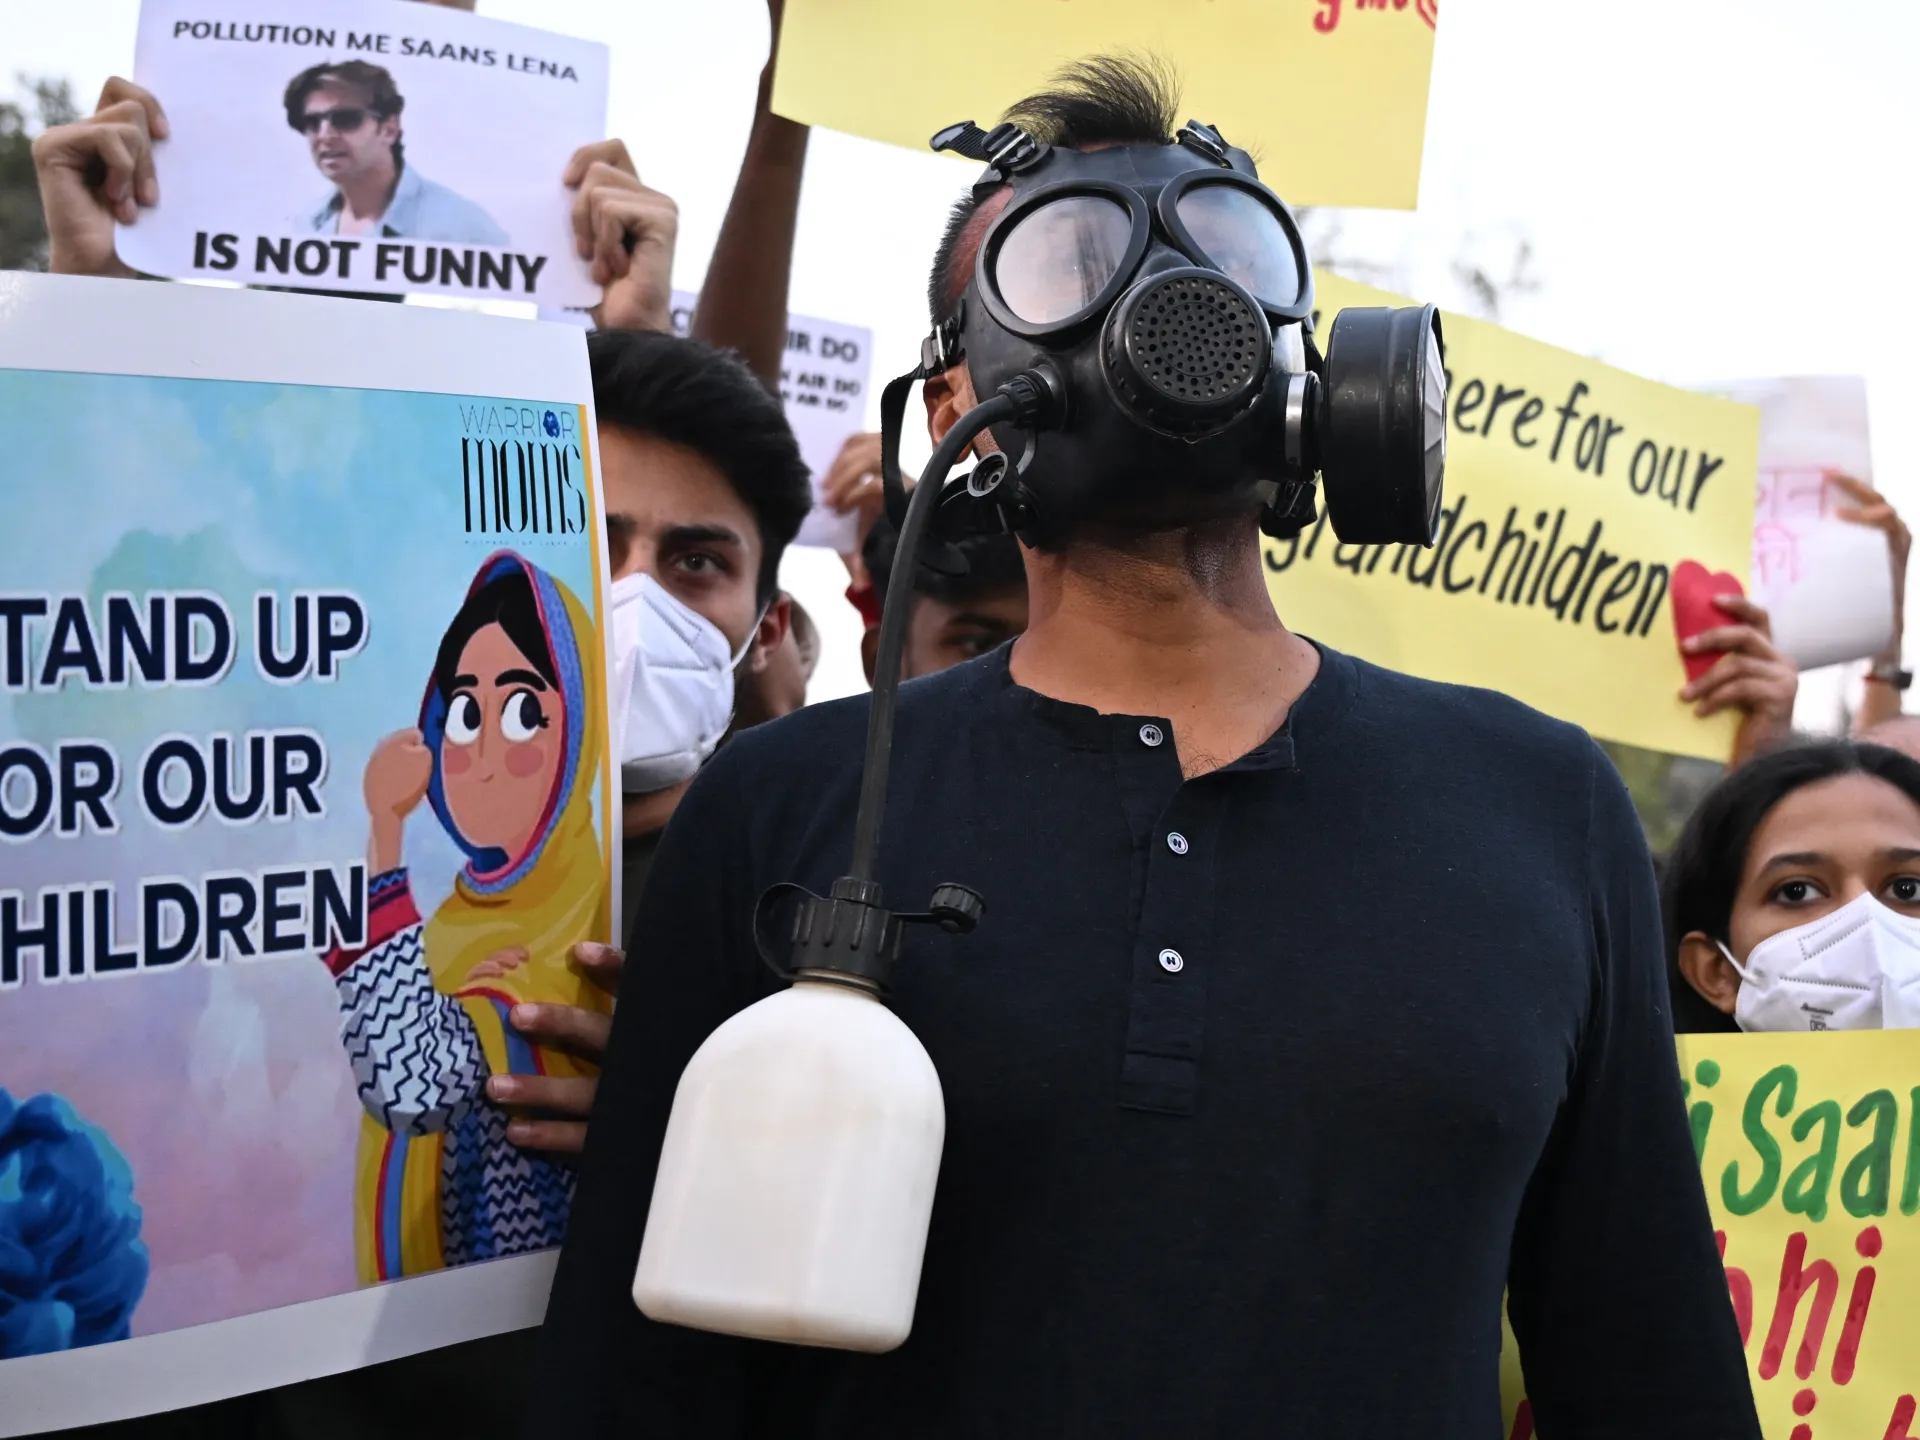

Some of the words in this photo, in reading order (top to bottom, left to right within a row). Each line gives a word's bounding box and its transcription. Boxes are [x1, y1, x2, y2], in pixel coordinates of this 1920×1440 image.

[173, 20, 336, 48] POLLUTION
[346, 31, 390, 54] ME
[400, 37, 497, 67] SAANS
[507, 53, 579, 83] LENA
[193, 230, 239, 271] IS
[254, 235, 360, 279] NOT
[374, 243, 548, 294] FUNNY
[821, 336, 860, 364] DO
[1548, 381, 1624, 477] for
[1629, 440, 1724, 513] our
[258, 595, 364, 678] UP
[142, 734, 322, 824] OUR
